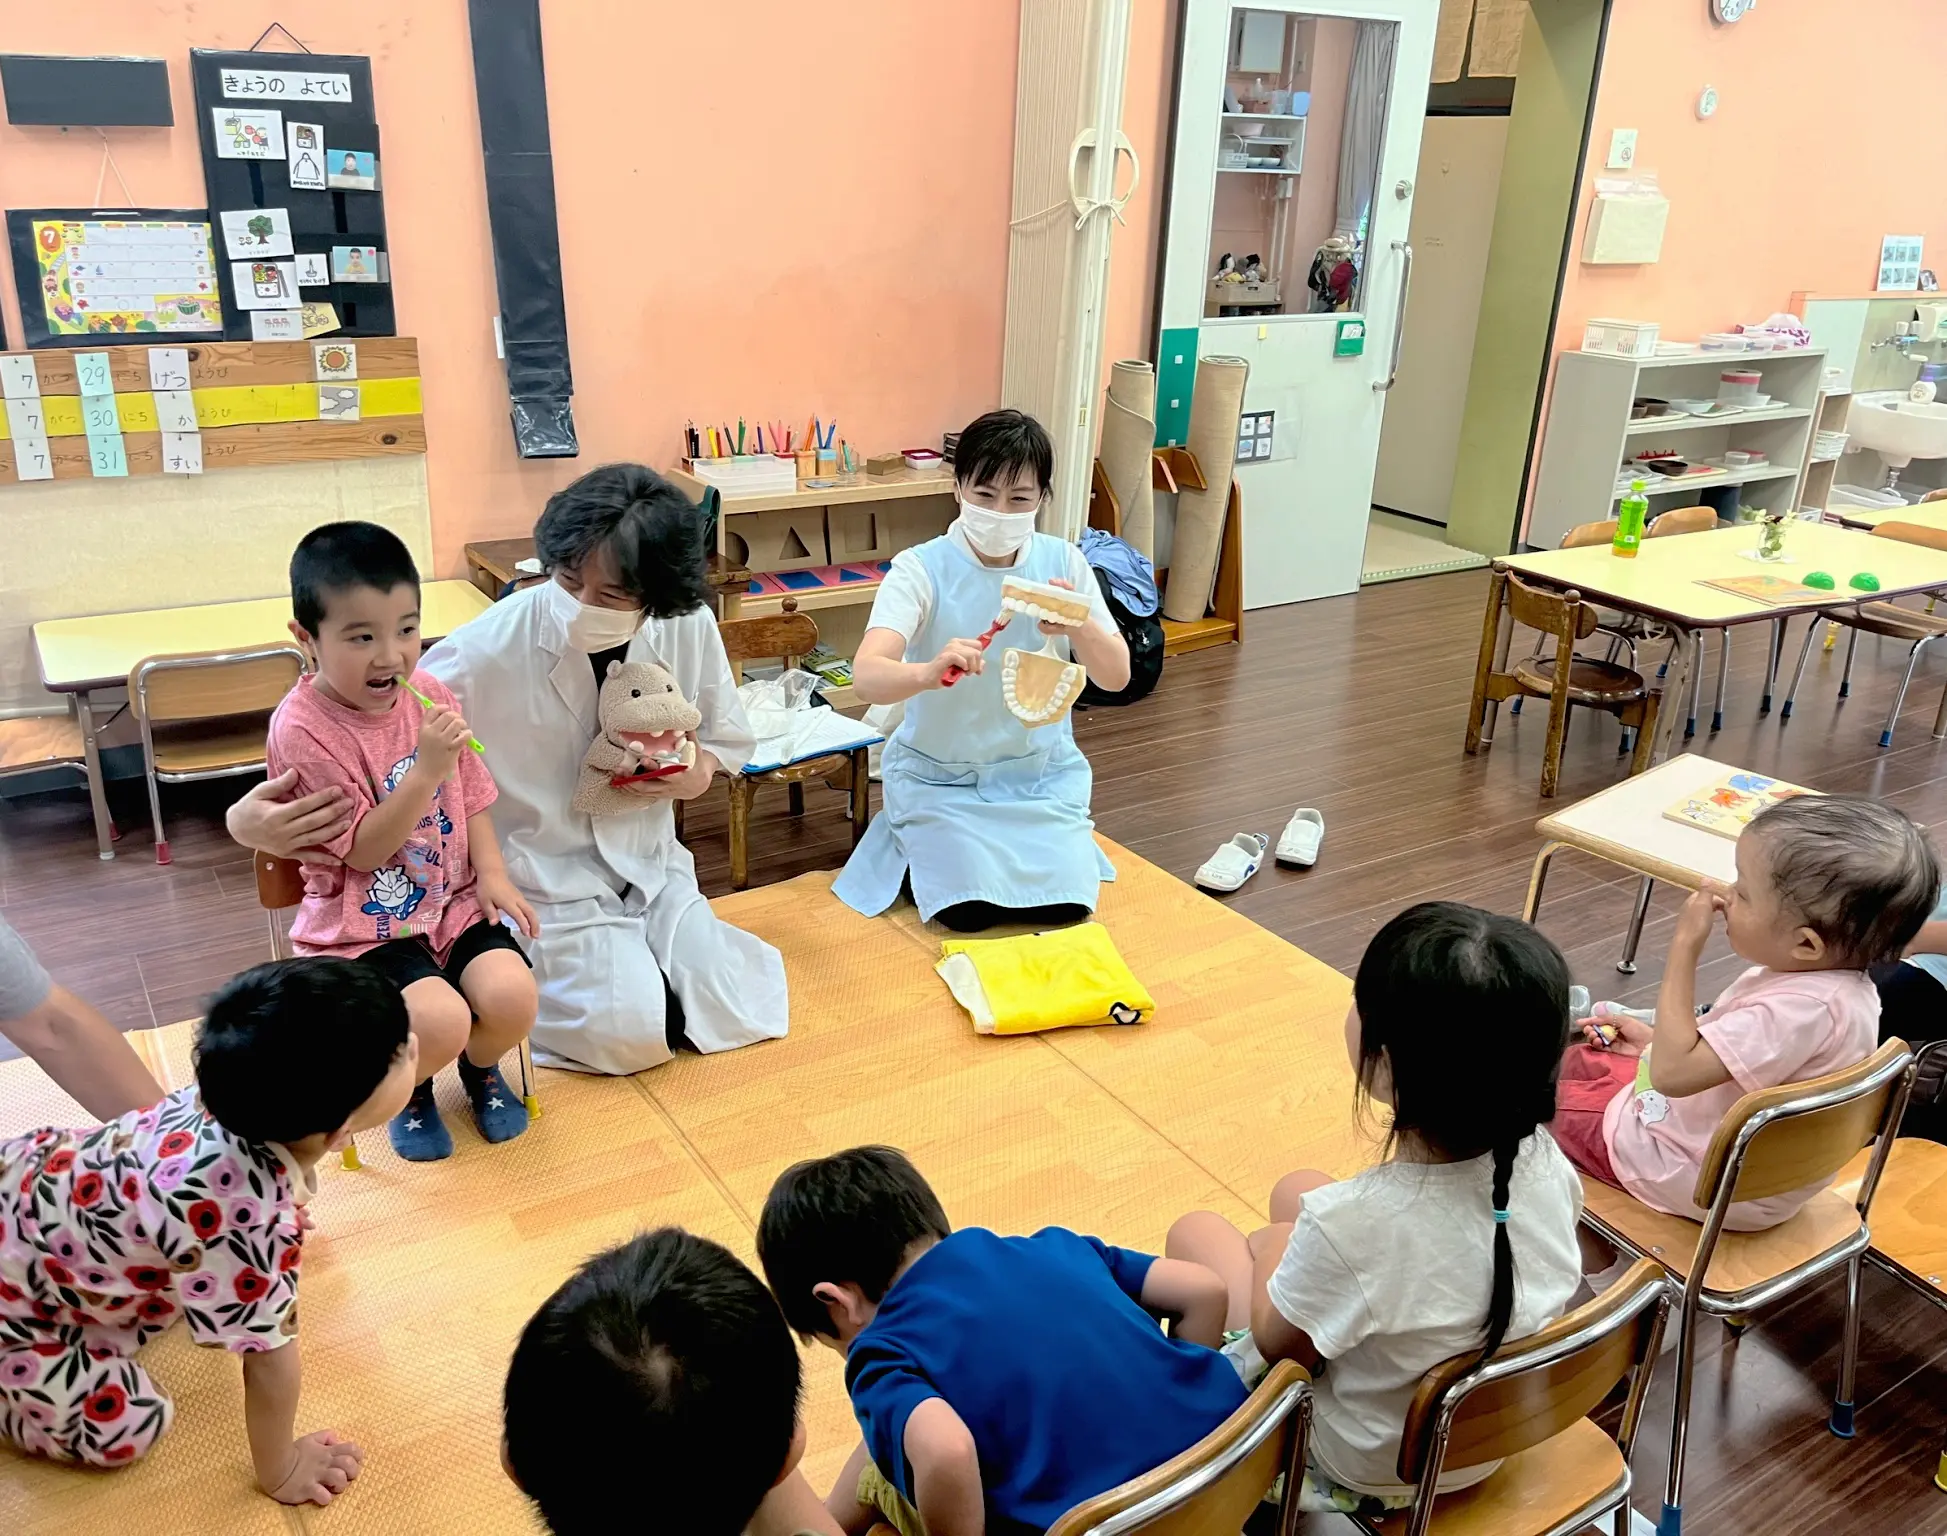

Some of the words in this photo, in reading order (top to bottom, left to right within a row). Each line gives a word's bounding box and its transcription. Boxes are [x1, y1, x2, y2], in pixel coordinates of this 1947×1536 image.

[224, 74, 285, 94] きょうの
[300, 78, 348, 96] よてい
[43, 230, 56, 244] 7
[21, 375, 33, 389] 7
[81, 366, 106, 387] 29
[116, 371, 142, 382] にち
[154, 371, 187, 388] げつ
[195, 368, 229, 379] ようび
[27, 415, 38, 430] 7
[50, 414, 77, 425] がつ
[90, 409, 114, 427] 30
[123, 411, 148, 422] にち
[178, 415, 193, 427] か
[200, 407, 232, 419] ようび
[33, 454, 45, 470] 7
[98, 450, 118, 470] 31
[169, 455, 199, 470] すい
[206, 444, 237, 456] ようび
[425, 848, 443, 868] UL
[377, 914, 391, 940] ZERO
